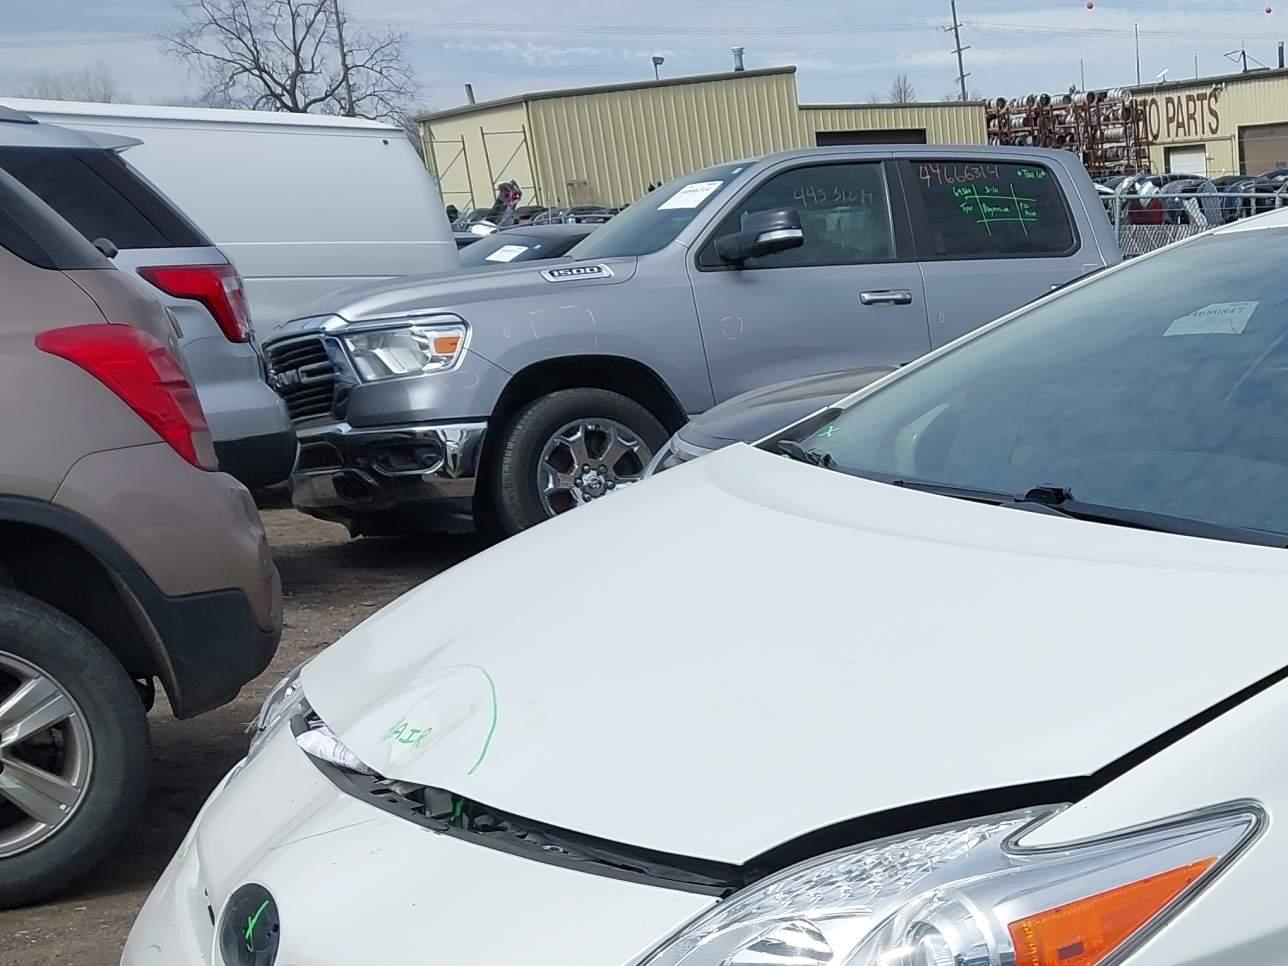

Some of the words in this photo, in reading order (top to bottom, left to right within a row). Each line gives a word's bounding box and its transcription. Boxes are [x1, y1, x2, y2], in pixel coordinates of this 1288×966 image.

[1165, 91, 1219, 138] PARTS
[550, 266, 600, 277] 1500
[384, 720, 432, 749] AIR
